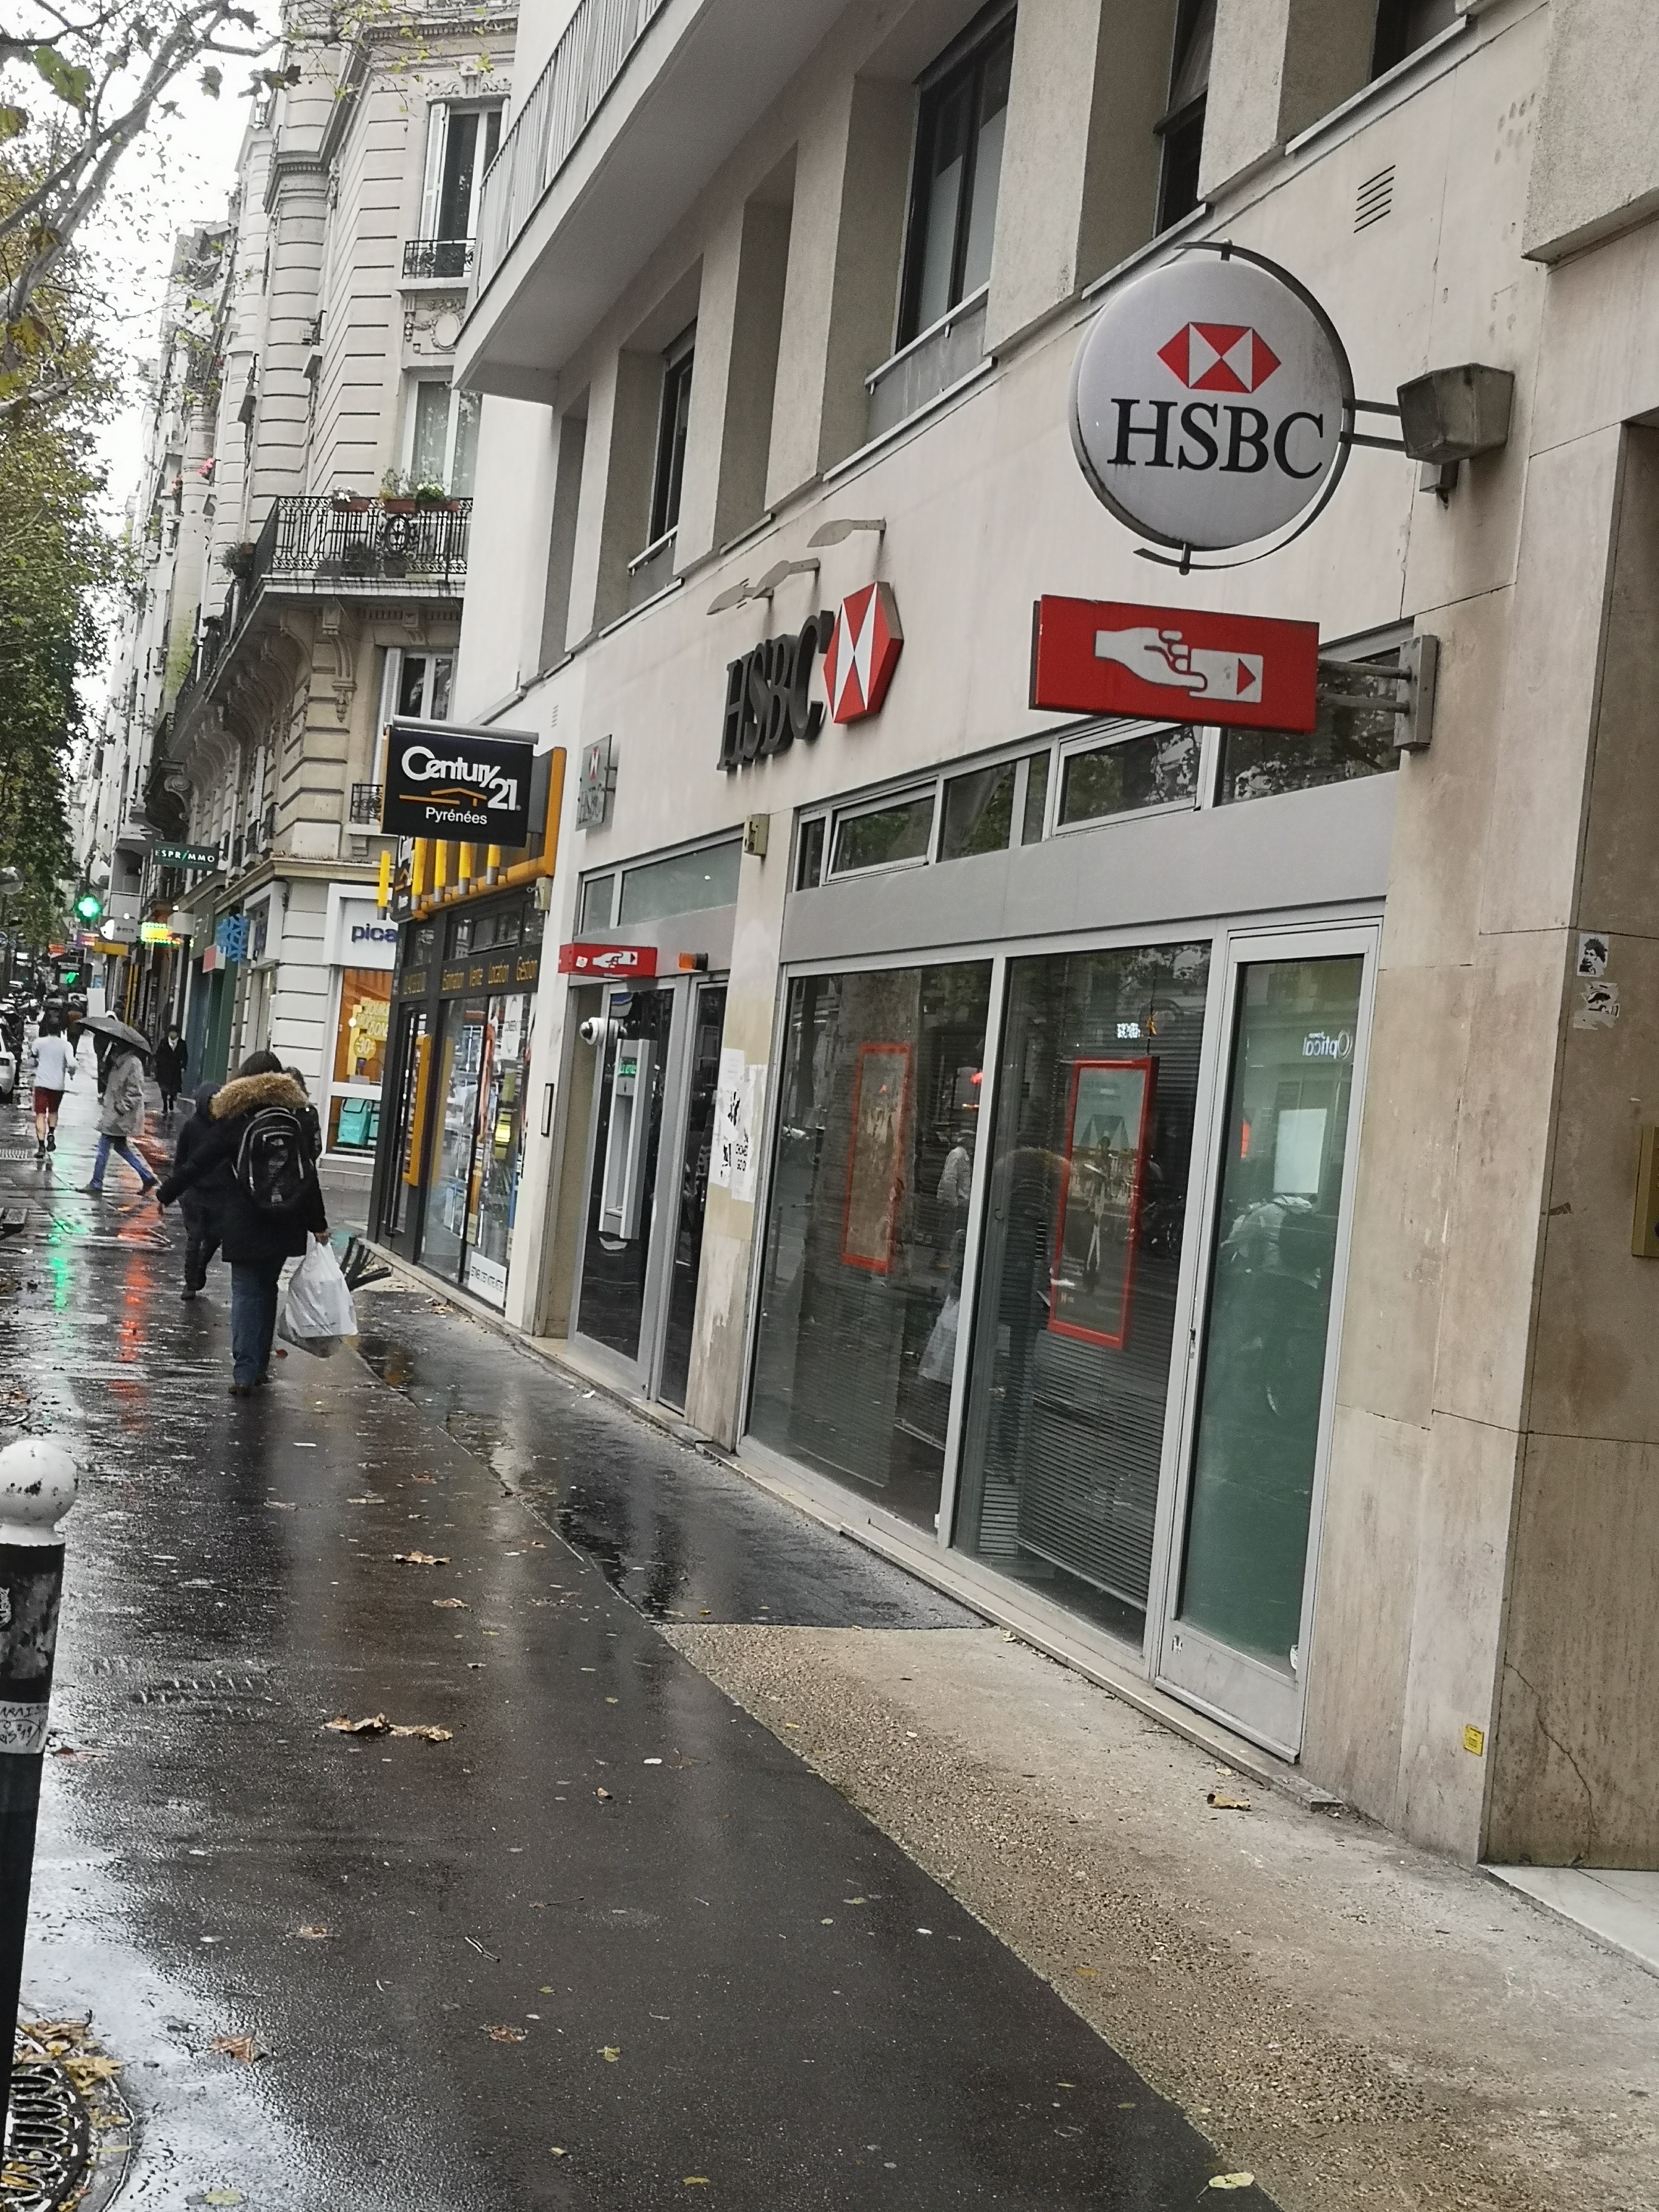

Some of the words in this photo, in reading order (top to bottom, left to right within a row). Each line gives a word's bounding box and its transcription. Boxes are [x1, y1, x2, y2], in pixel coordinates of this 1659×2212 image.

[1107, 398, 1323, 479] HSBC
[717, 611, 834, 771] HSBC
[401, 746, 501, 788] Century
[488, 777, 517, 811] 21
[426, 807, 487, 825] Pyrénées
